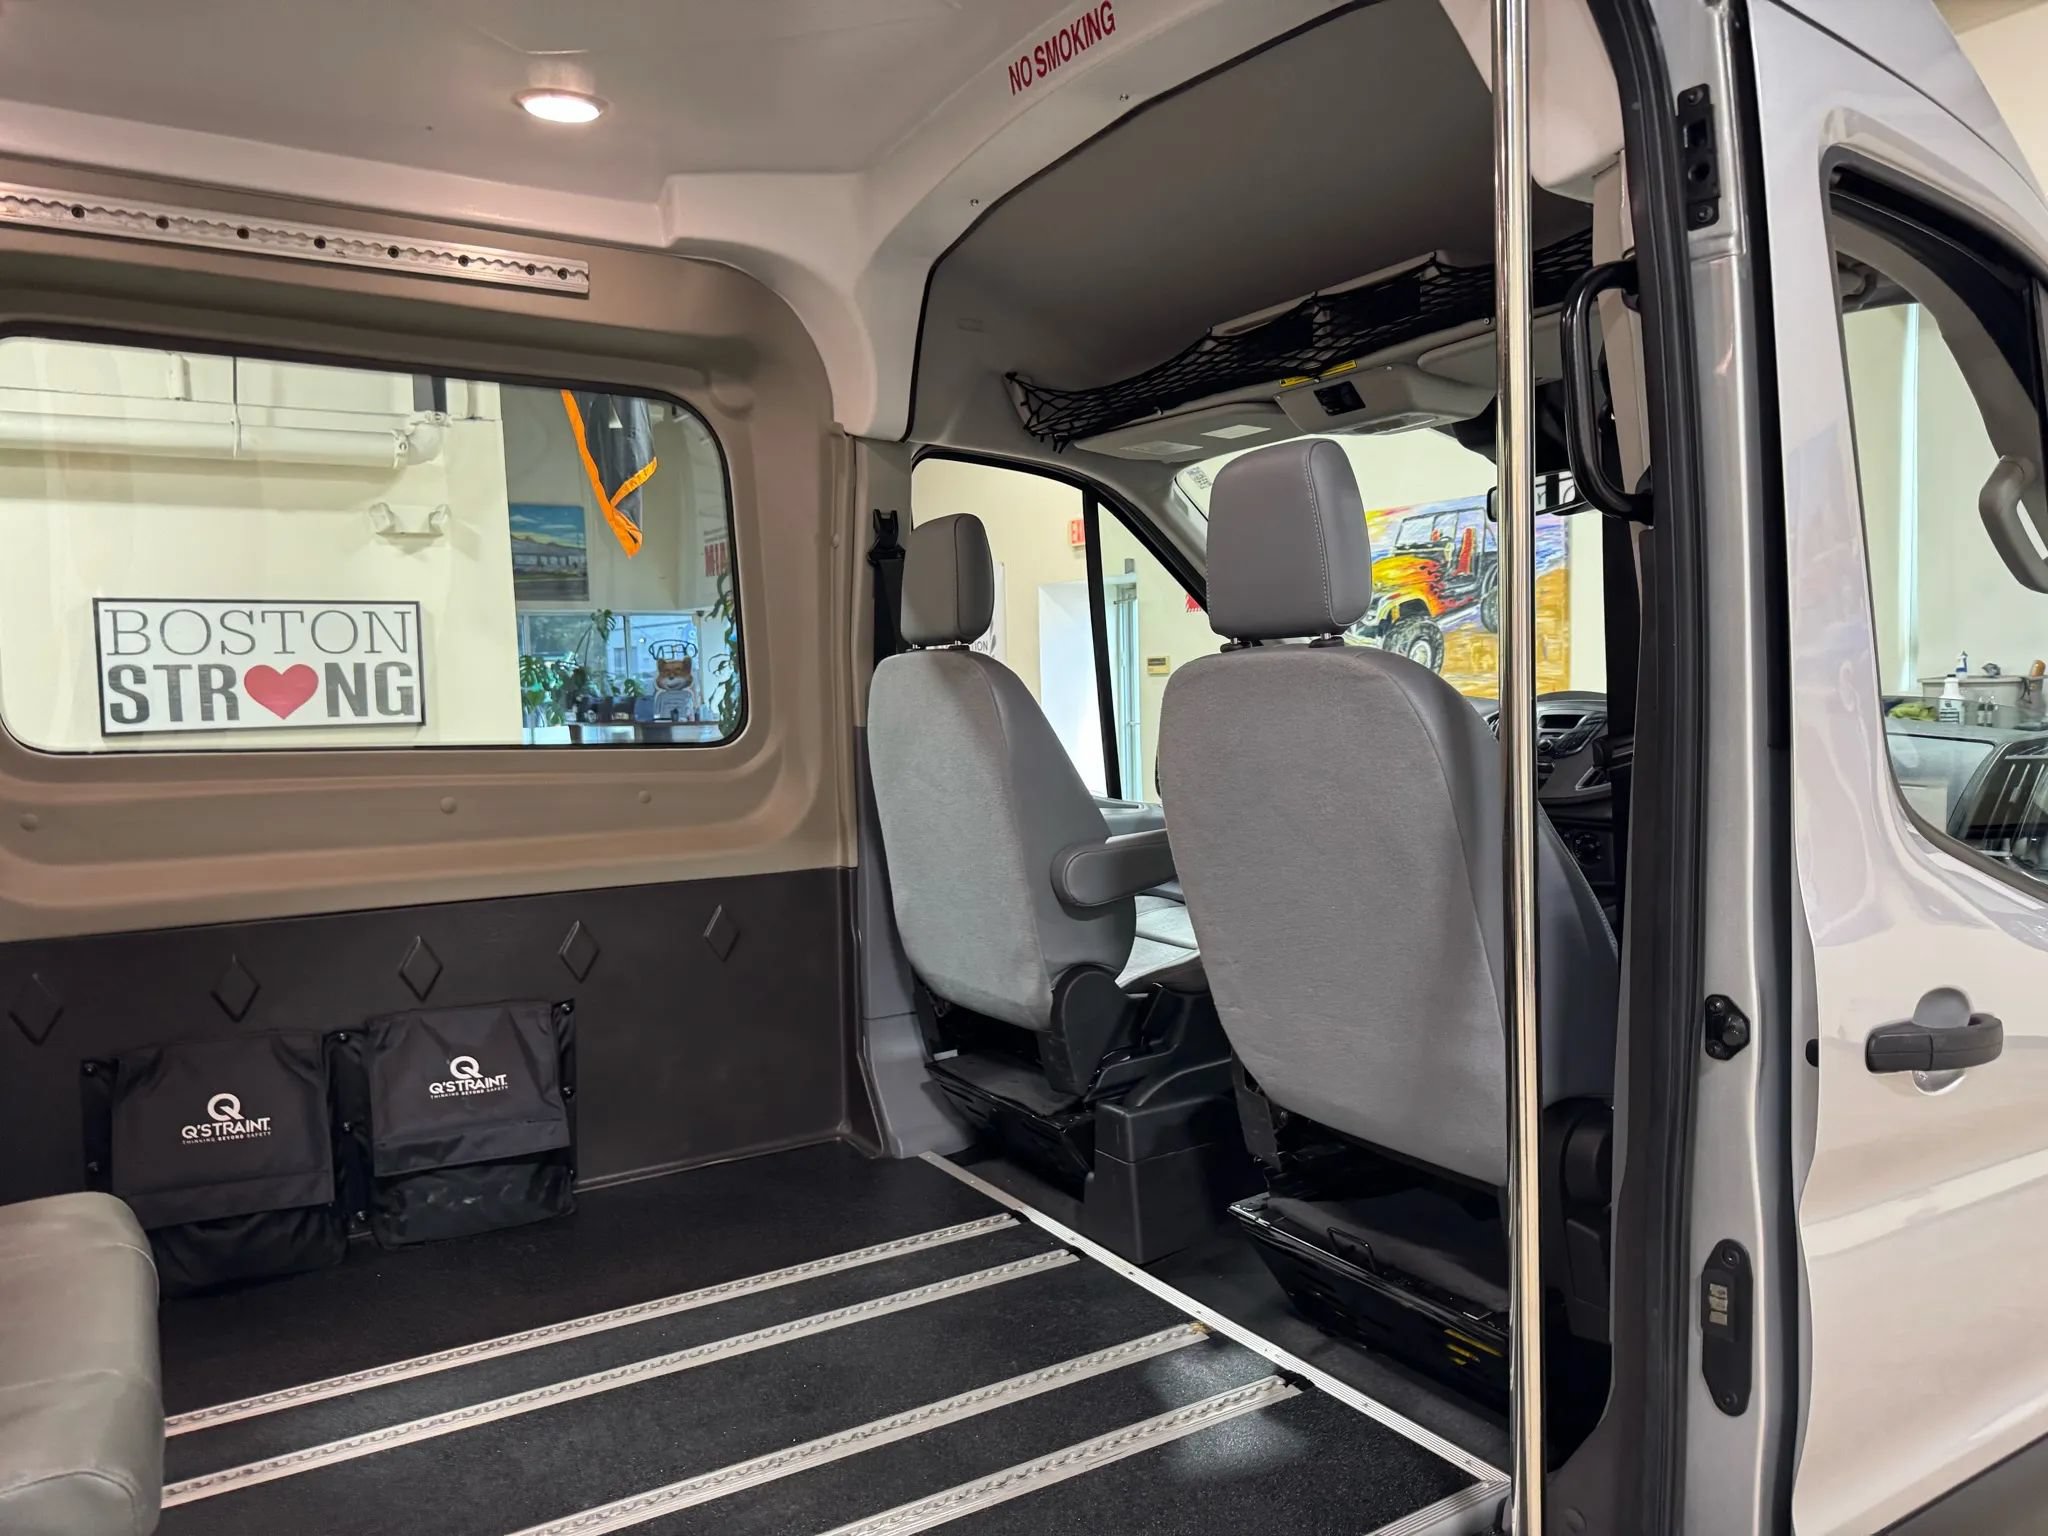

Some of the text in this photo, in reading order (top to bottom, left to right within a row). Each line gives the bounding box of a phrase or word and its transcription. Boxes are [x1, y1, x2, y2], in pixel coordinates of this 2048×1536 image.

[1008, 0, 1116, 96] NO SMOKING
[103, 609, 412, 656] BOSTON
[107, 661, 416, 724] STRNG
[428, 1073, 508, 1095] Q'STRAINT
[181, 1117, 272, 1139] Q'STRAINT
